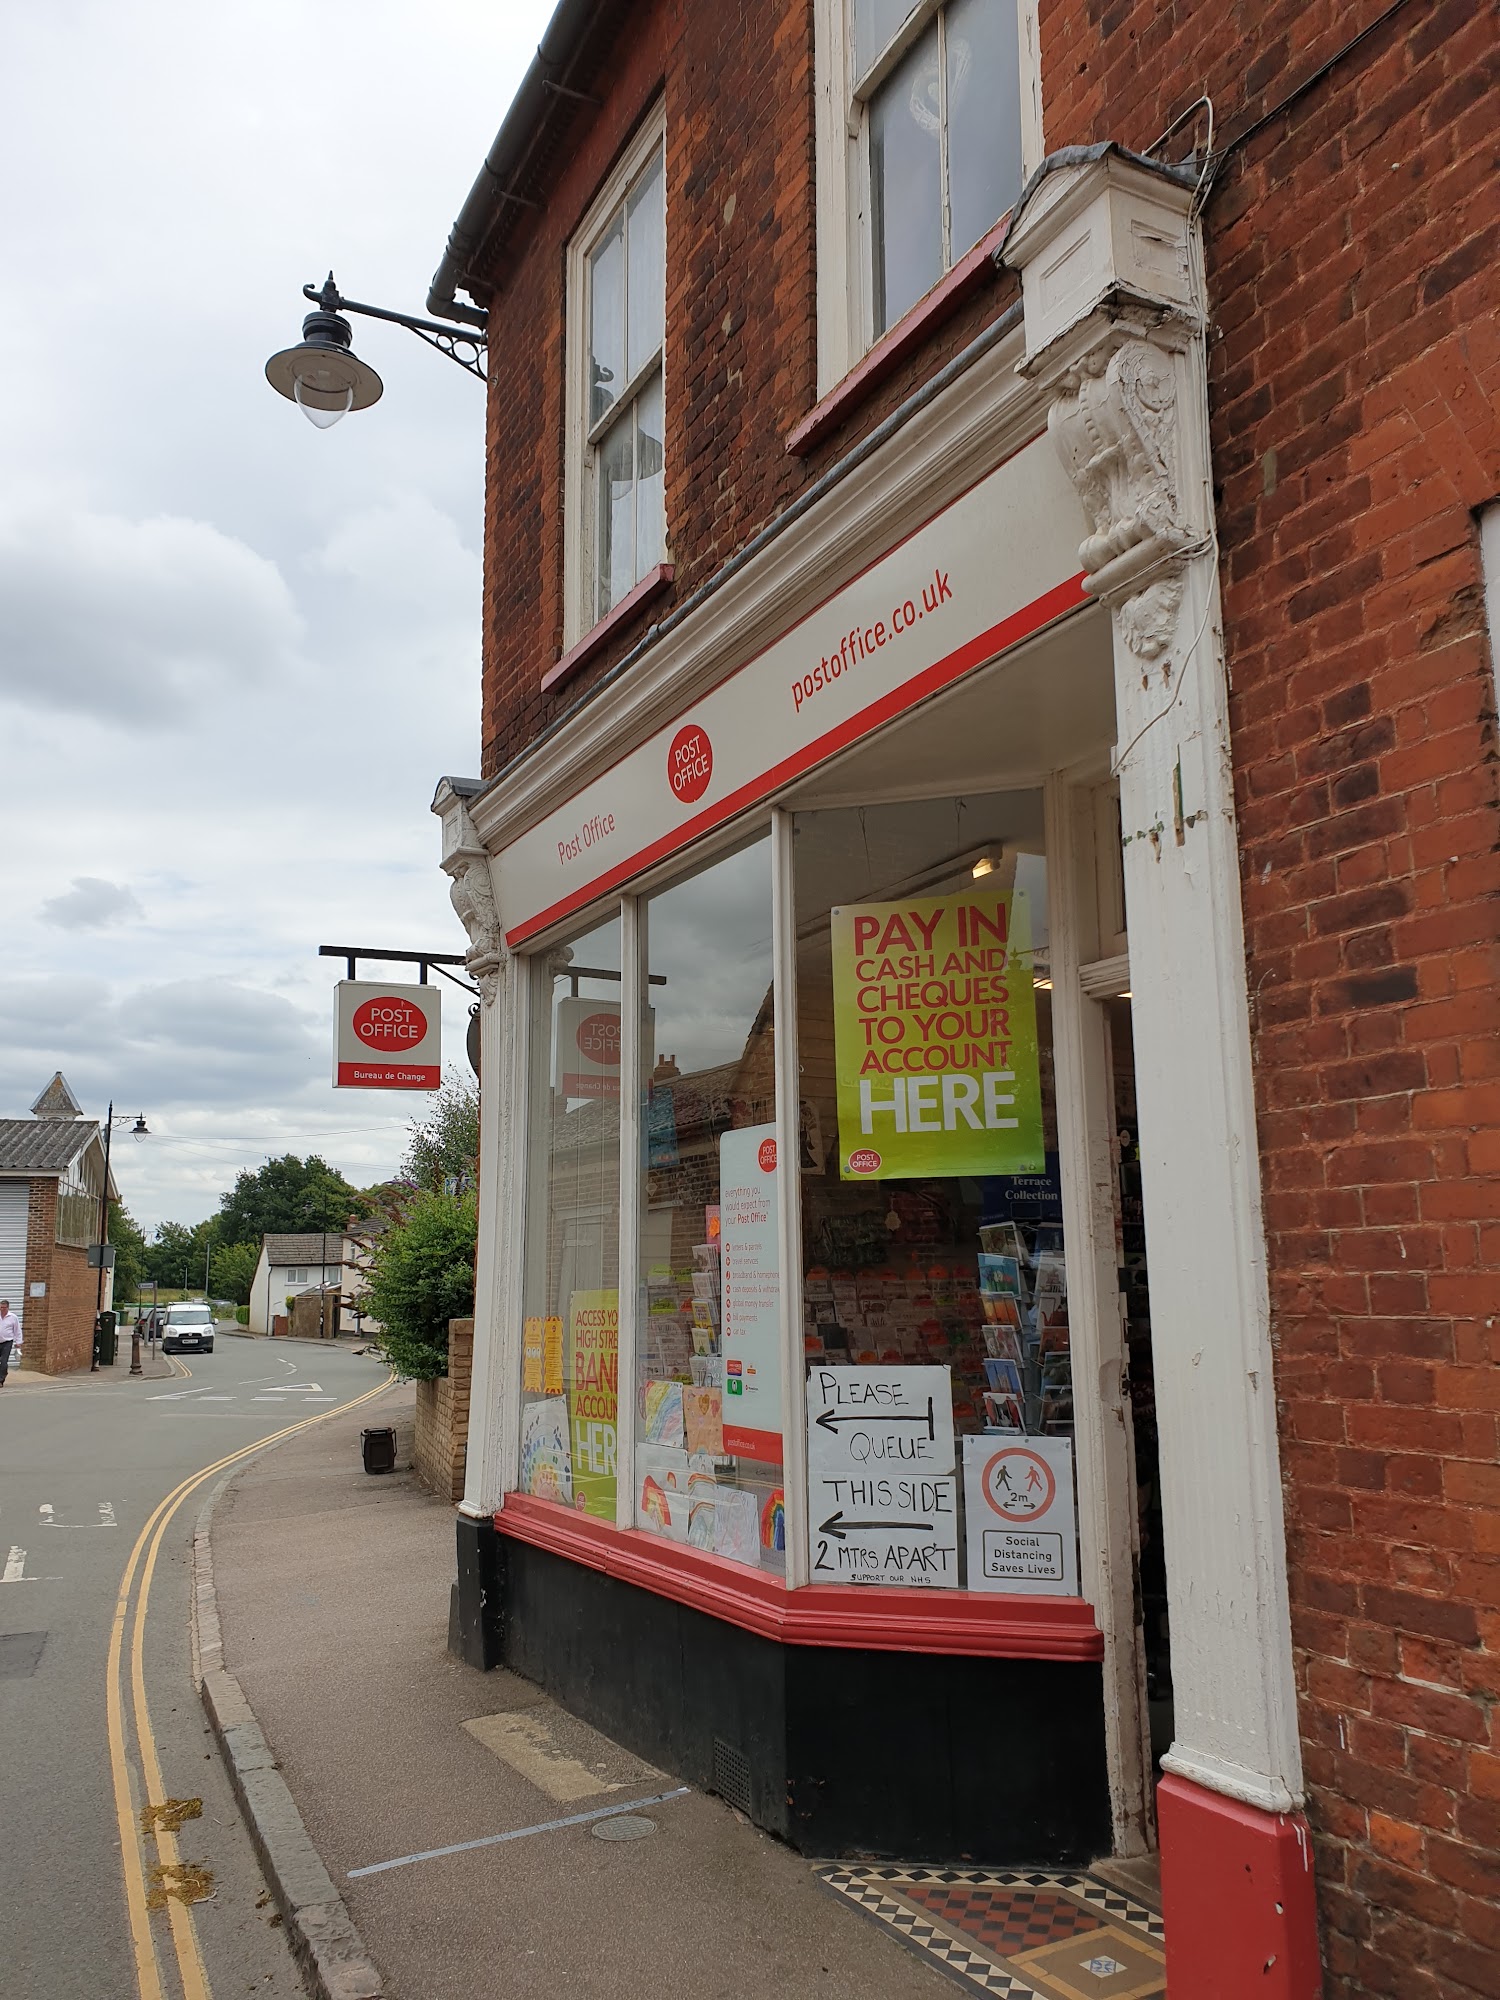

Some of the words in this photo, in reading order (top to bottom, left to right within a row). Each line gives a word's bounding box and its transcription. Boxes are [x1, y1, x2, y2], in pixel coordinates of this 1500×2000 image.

[791, 568, 953, 713] postoffice.co.uk
[674, 734, 700, 768] POST
[673, 753, 710, 791] OFFICE
[557, 833, 582, 865] Post
[582, 813, 616, 848] Office
[853, 907, 945, 956] PAY
[956, 902, 1009, 948] IN
[855, 954, 935, 982] CASH
[941, 948, 1008, 977] AND
[856, 975, 1009, 1013] CHEQUES
[370, 1007, 413, 1022] POST
[360, 1022, 418, 1038] OFFICE
[859, 1016, 905, 1046] TO
[912, 1008, 1011, 1042] YOUR
[859, 1041, 1013, 1075] ACCOUNT
[354, 1070, 382, 1079] Bureau
[385, 1071, 395, 1080] de
[397, 1071, 426, 1082] Change
[859, 1071, 1019, 1134] HERE
[762, 1144, 775, 1155] POST
[856, 1153, 875, 1161] POST
[852, 1160, 878, 1168] OFFICE
[1011, 1176, 1052, 1186] Terrace
[725, 1186, 750, 1198] everything
[751, 1186, 760, 1197] you
[1005, 1190, 1058, 1200] Collection
[725, 1202, 739, 1212] would
[741, 1200, 757, 1211] expect
[758, 1198, 770, 1209] from
[725, 1216, 737, 1227] your
[738, 1213, 749, 1224] Post
[575, 1309, 606, 1327] ACCESS
[576, 1329, 598, 1349] HIGH
[819, 1371, 910, 1406] PLEASE
[849, 1432, 935, 1465] QUEUE
[822, 1480, 893, 1507] THIS
[897, 1481, 953, 1513] SIDE
[1010, 1492, 1029, 1503] 2m
[1005, 1535, 1040, 1547] Social
[814, 1540, 835, 1571] 2
[838, 1546, 879, 1570] MTRS
[883, 1543, 956, 1572] APART
[994, 1548, 1052, 1563] Distancing
[991, 1562, 1024, 1574] Saves
[1027, 1563, 1056, 1575] Lives
[849, 1573, 886, 1582] SUPPORT
[889, 1574, 905, 1582] OUR
[910, 1575, 932, 1584] NHS
